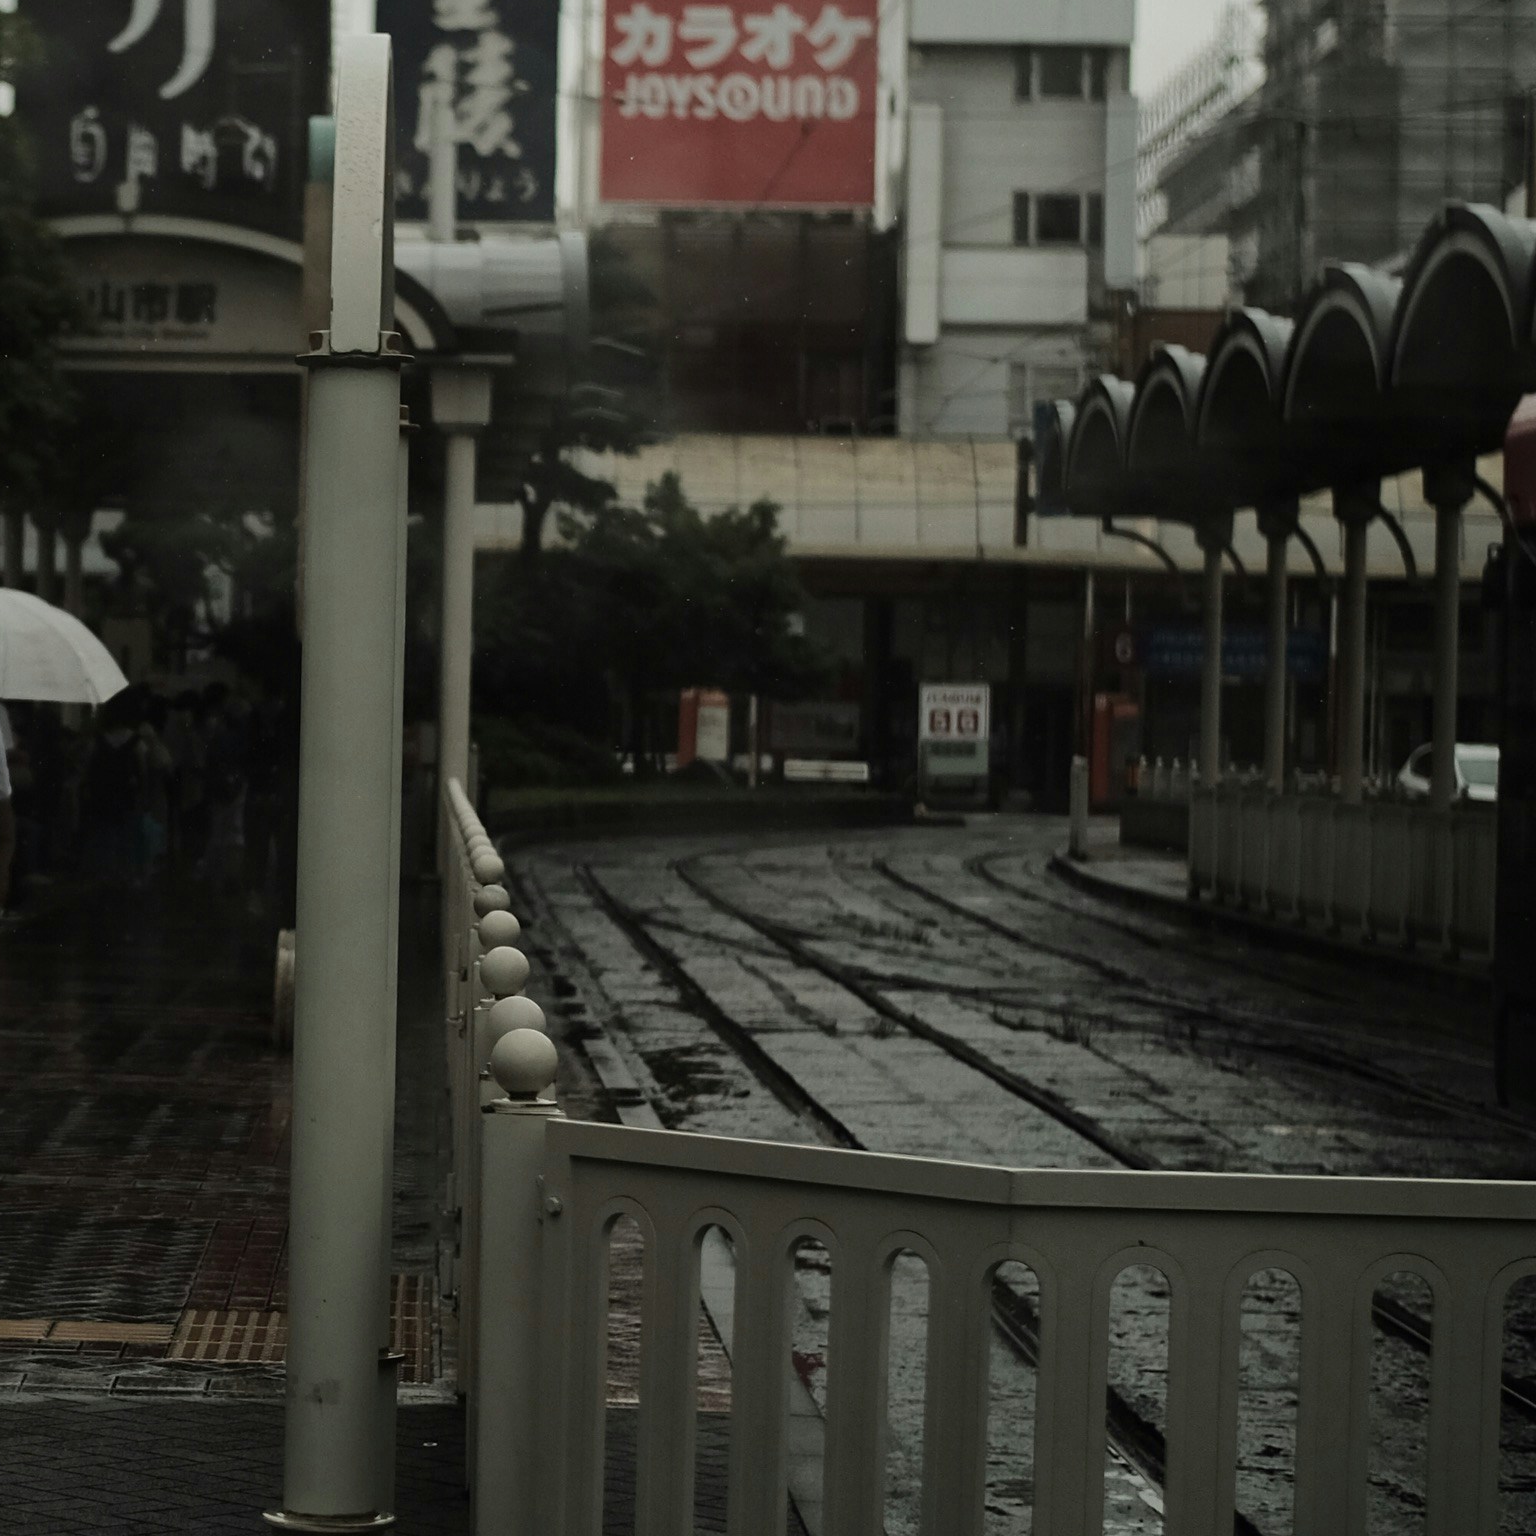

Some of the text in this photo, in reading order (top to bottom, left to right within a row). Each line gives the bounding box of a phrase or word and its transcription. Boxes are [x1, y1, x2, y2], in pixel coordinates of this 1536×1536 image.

[611, 3, 871, 69] カラオケ
[618, 73, 860, 122] JOYSOUND
[87, 281, 219, 324] 山市駅
